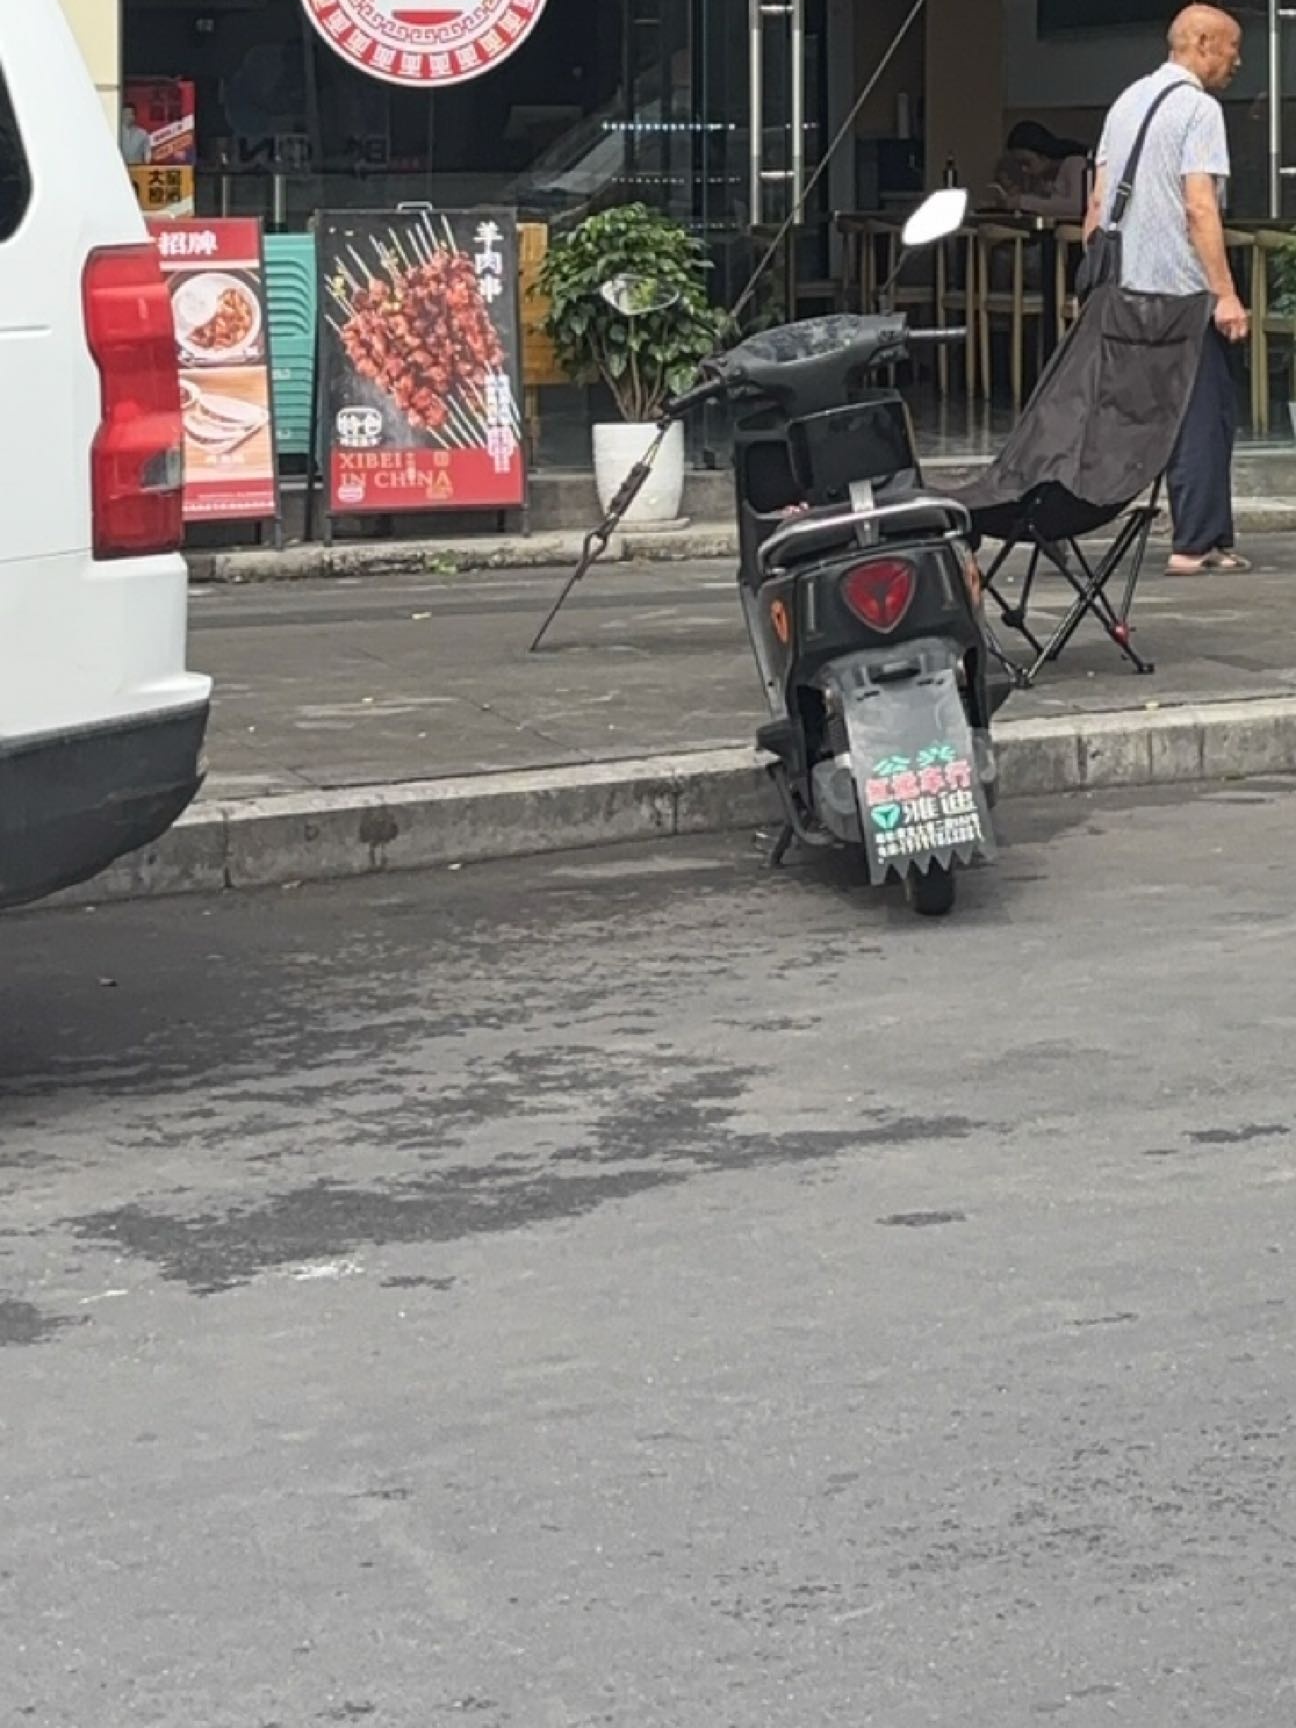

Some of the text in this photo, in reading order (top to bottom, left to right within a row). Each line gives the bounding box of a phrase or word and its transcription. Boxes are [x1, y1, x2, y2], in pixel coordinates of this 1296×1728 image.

[473, 220, 504, 304] 羊肉串
[338, 452, 401, 469] XIBEI
[373, 470, 451, 489] CHINA
